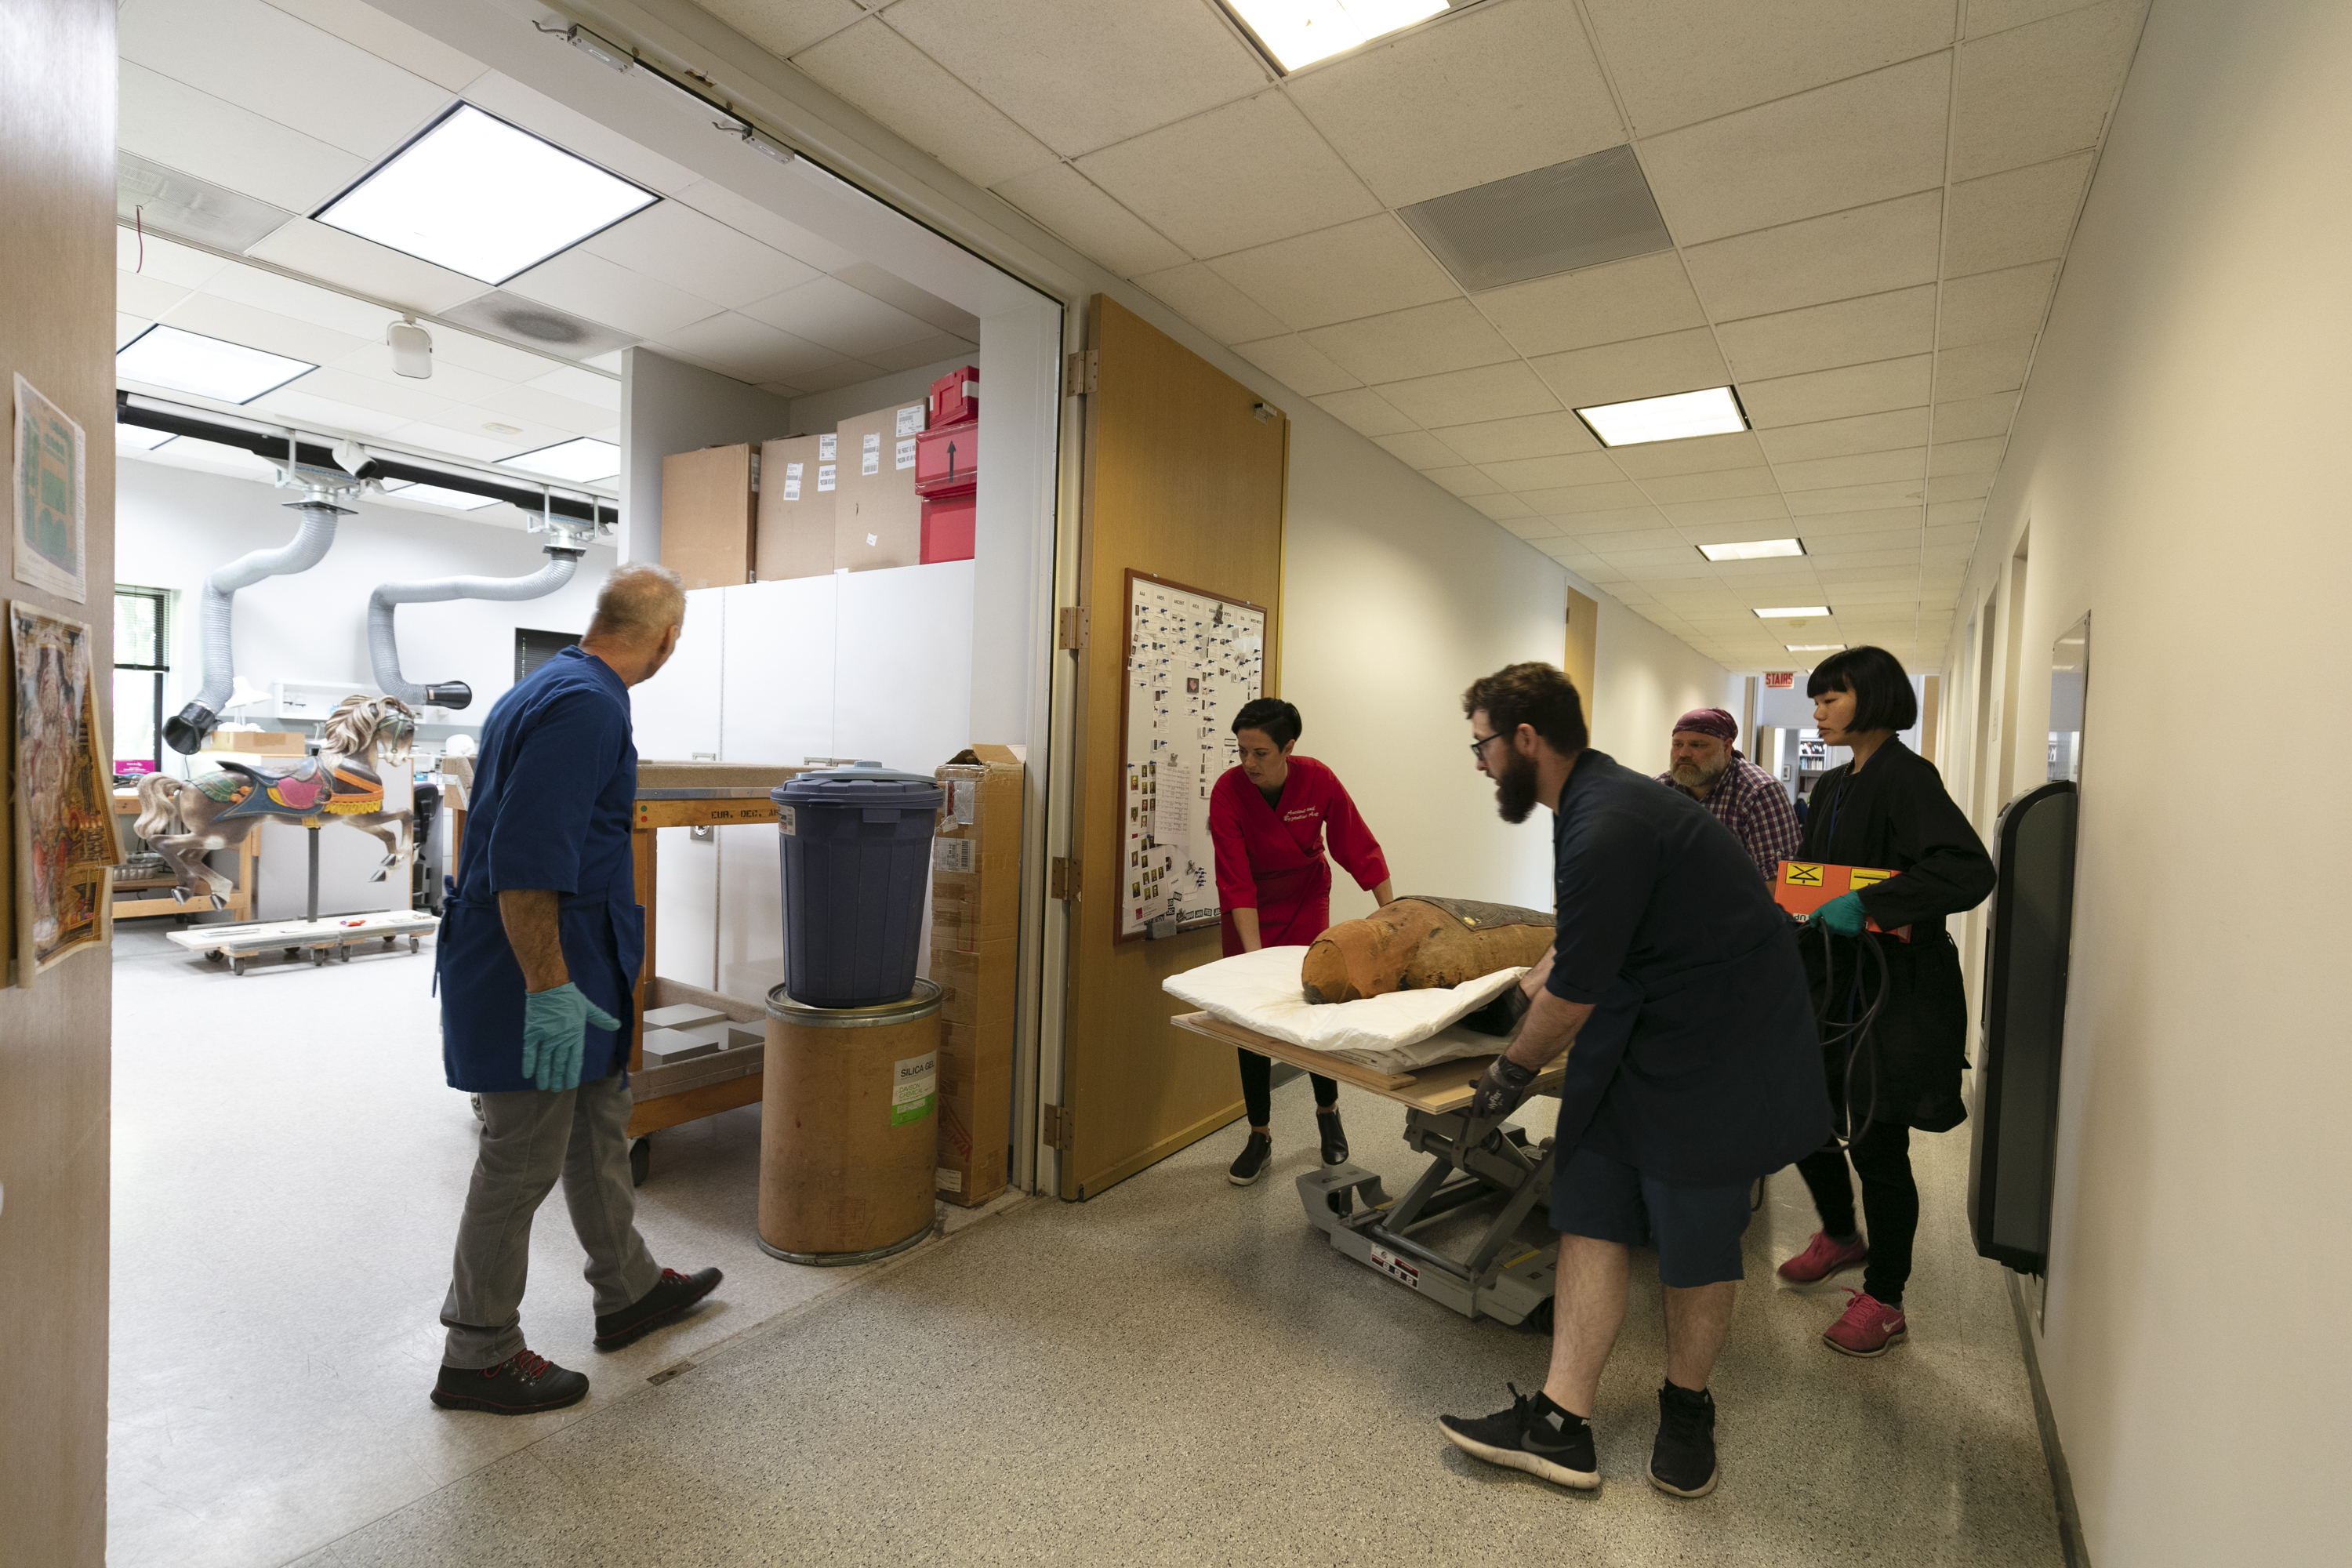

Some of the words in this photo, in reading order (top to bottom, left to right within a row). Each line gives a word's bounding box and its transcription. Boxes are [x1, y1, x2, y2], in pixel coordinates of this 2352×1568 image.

[1766, 673, 1794, 685] STAIRS
[710, 810, 734, 819] EUR.
[740, 809, 762, 818] DEC.
[900, 1064, 924, 1077] SILICA
[925, 1060, 935, 1070] GEL
[898, 1087, 923, 1099] CHEMICAL
[899, 1083, 920, 1093] DAVISON
